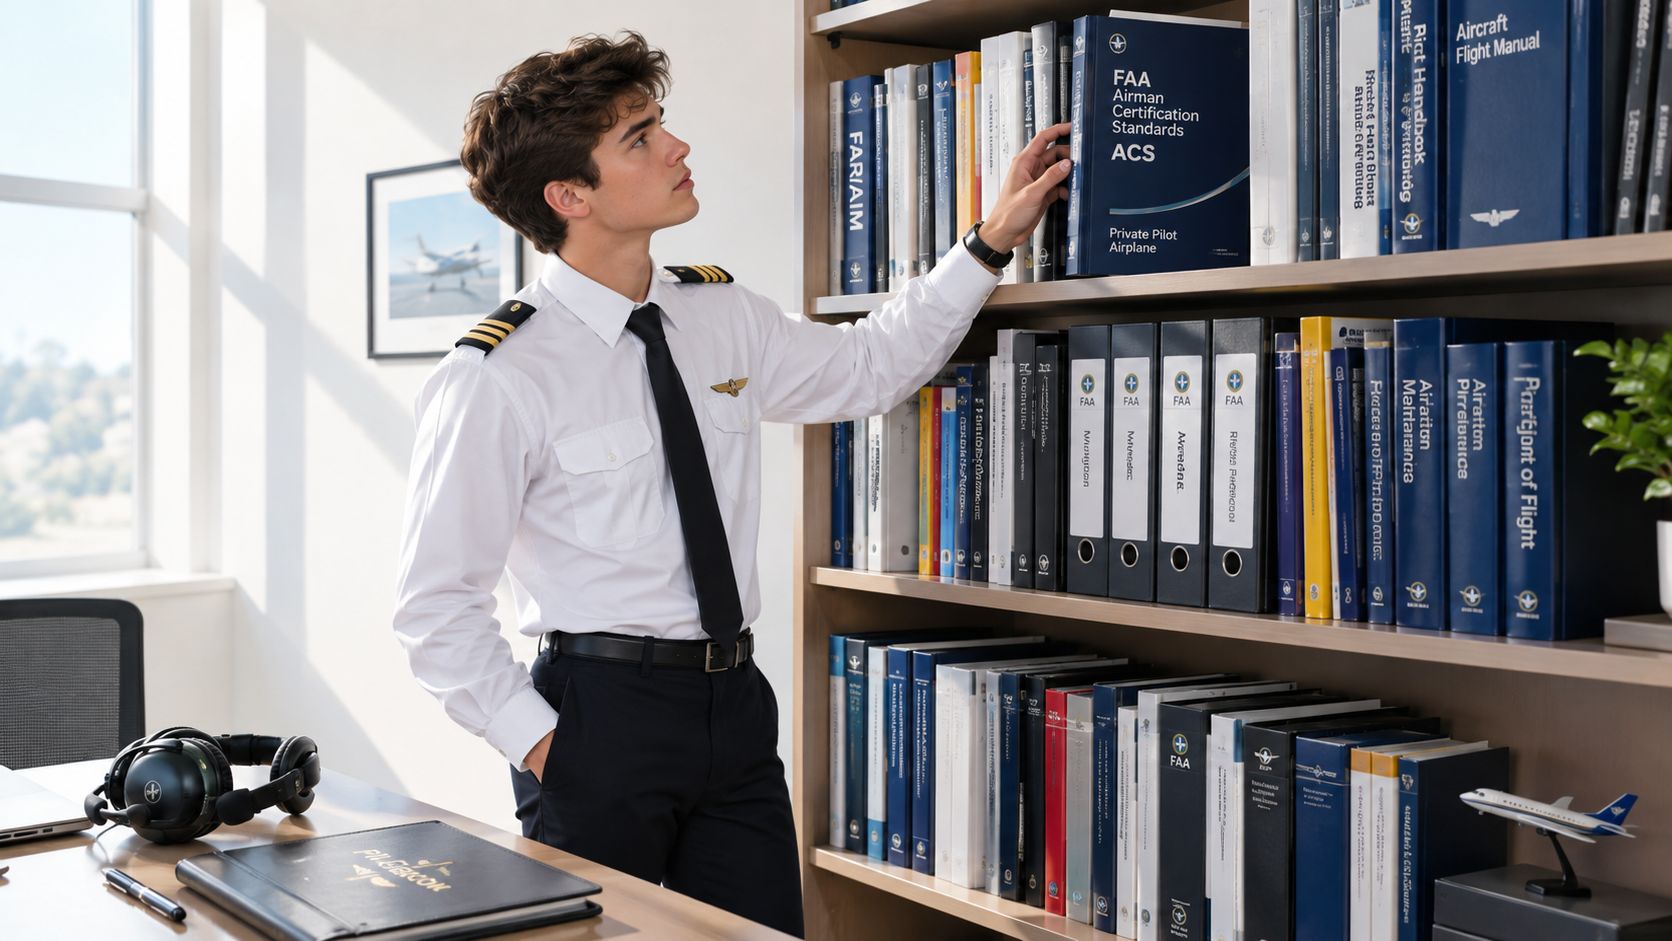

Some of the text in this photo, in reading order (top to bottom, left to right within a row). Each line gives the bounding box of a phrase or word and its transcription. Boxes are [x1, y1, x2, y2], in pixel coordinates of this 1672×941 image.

[1456, 13, 1508, 41] Aircraft
[1456, 30, 1540, 65] Flight Manual
[1113, 69, 1151, 87] FAA
[1112, 88, 1164, 104] Airman
[1112, 104, 1199, 122] Certification
[1112, 120, 1184, 136] Standards
[1111, 143, 1155, 162] ACS
[849, 131, 864, 231] FAR/AIM
[1109, 227, 1178, 240] Private Pilot
[1109, 241, 1157, 255] Airplane
[1079, 396, 1095, 406] FAA
[1123, 396, 1139, 406] FAA
[1173, 396, 1191, 406] FAA
[1225, 395, 1243, 405] FAA
[1520, 468, 1537, 490] of
[1516, 495, 1537, 549] Flight
[1170, 755, 1190, 769] FAA
